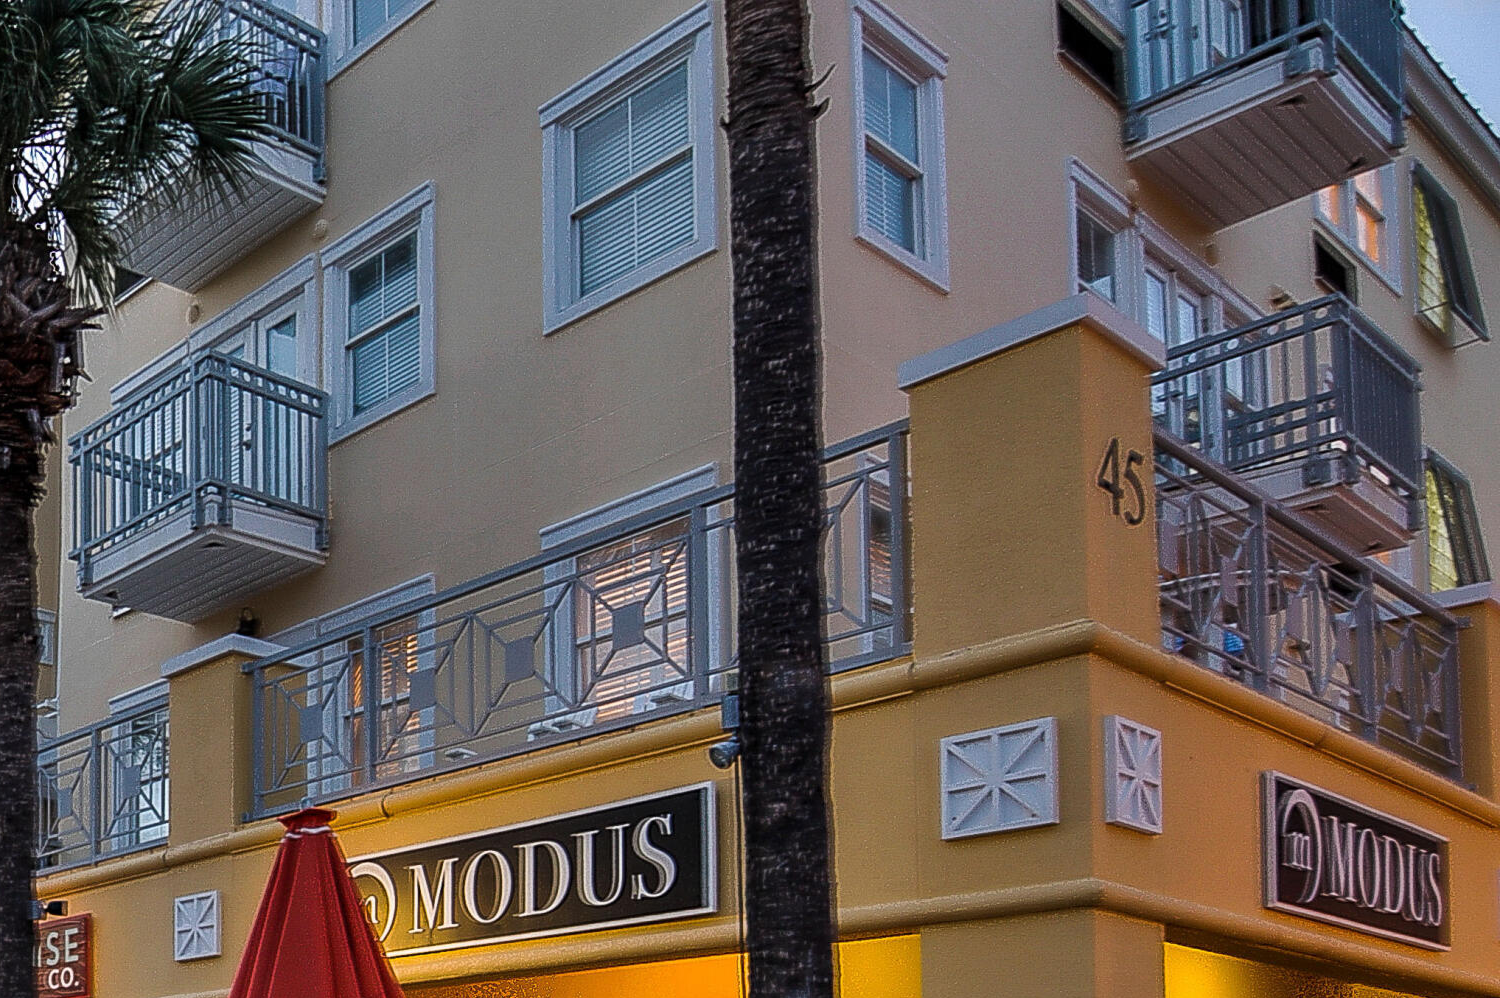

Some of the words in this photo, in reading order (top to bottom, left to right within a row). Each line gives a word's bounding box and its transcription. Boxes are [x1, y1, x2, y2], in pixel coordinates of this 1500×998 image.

[1097, 437, 1145, 525] 45
[408, 812, 678, 935] MODUS
[1321, 815, 1442, 927] MODUS
[48, 967, 79, 990] CO.
